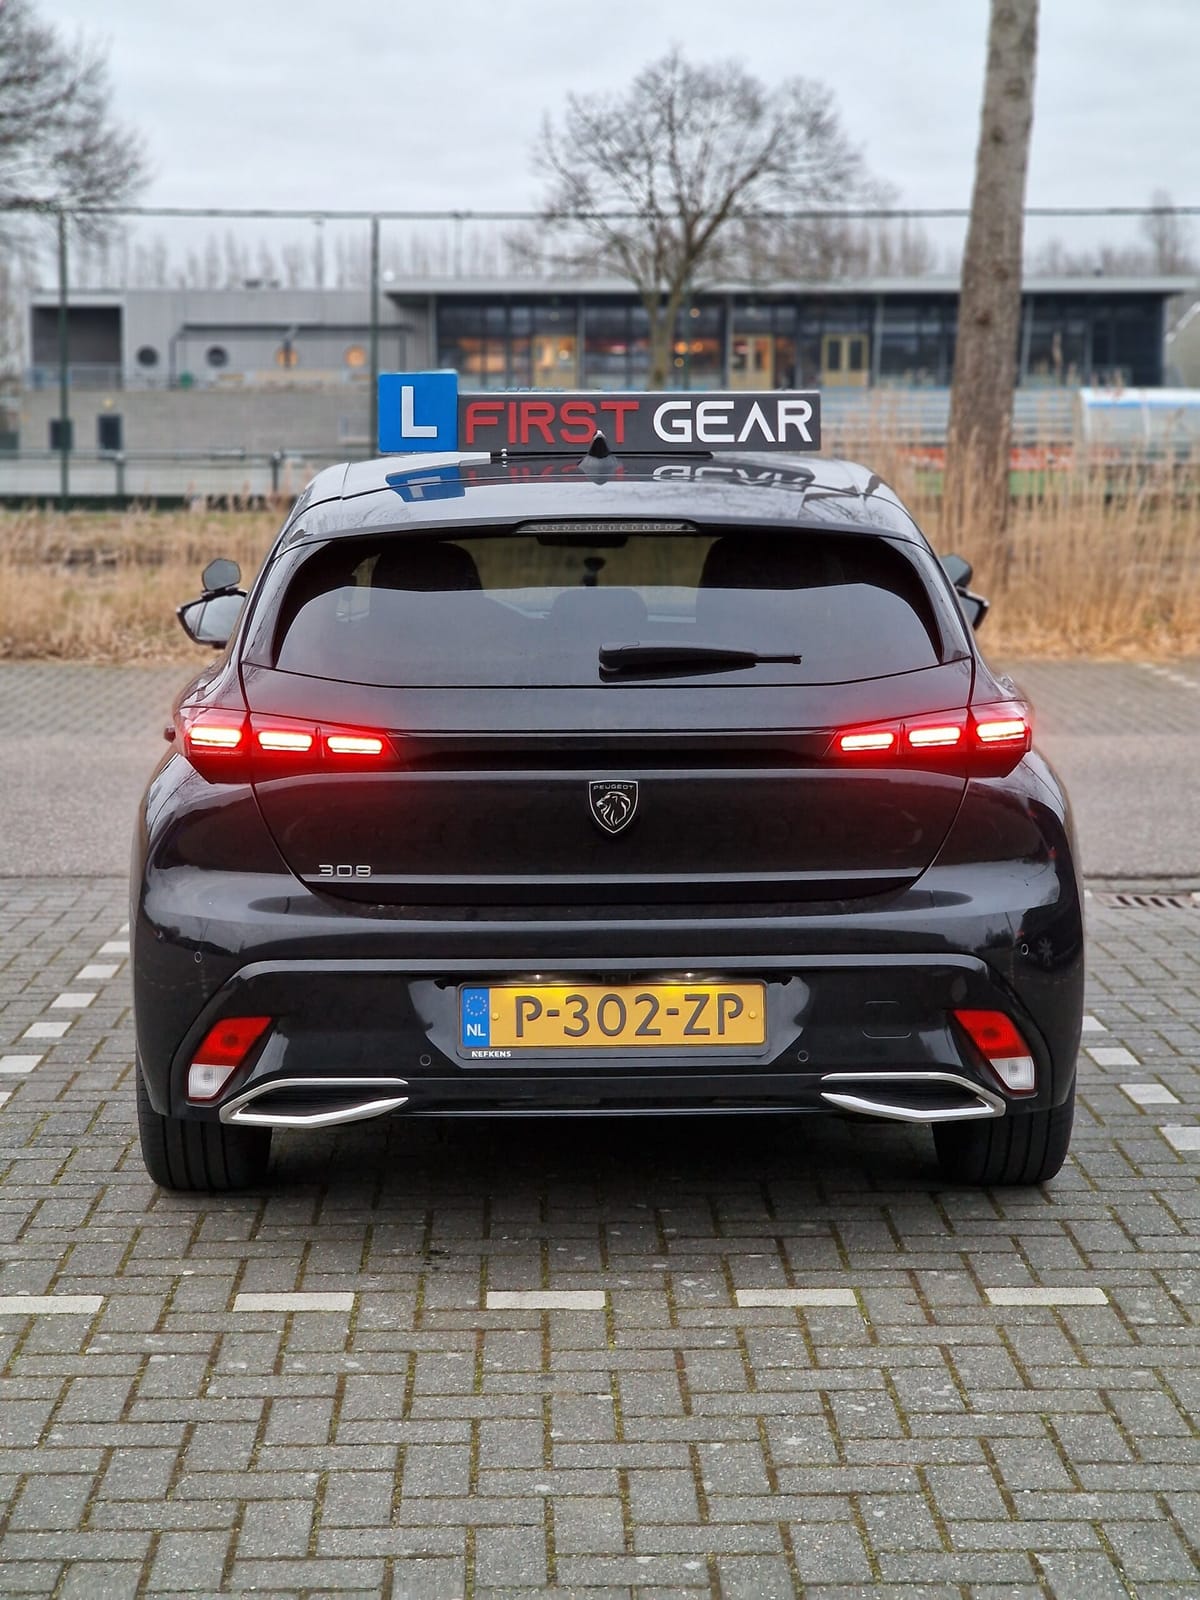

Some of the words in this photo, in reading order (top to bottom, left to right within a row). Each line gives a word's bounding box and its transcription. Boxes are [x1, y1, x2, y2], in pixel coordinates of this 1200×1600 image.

[401, 386, 438, 439] L
[465, 401, 639, 444] FIRST
[653, 400, 813, 443] GEAR
[318, 864, 372, 877] 308
[513, 992, 744, 1037] P-302-ZP
[466, 1024, 486, 1037] NL
[471, 1050, 512, 1058] NEFKENS
